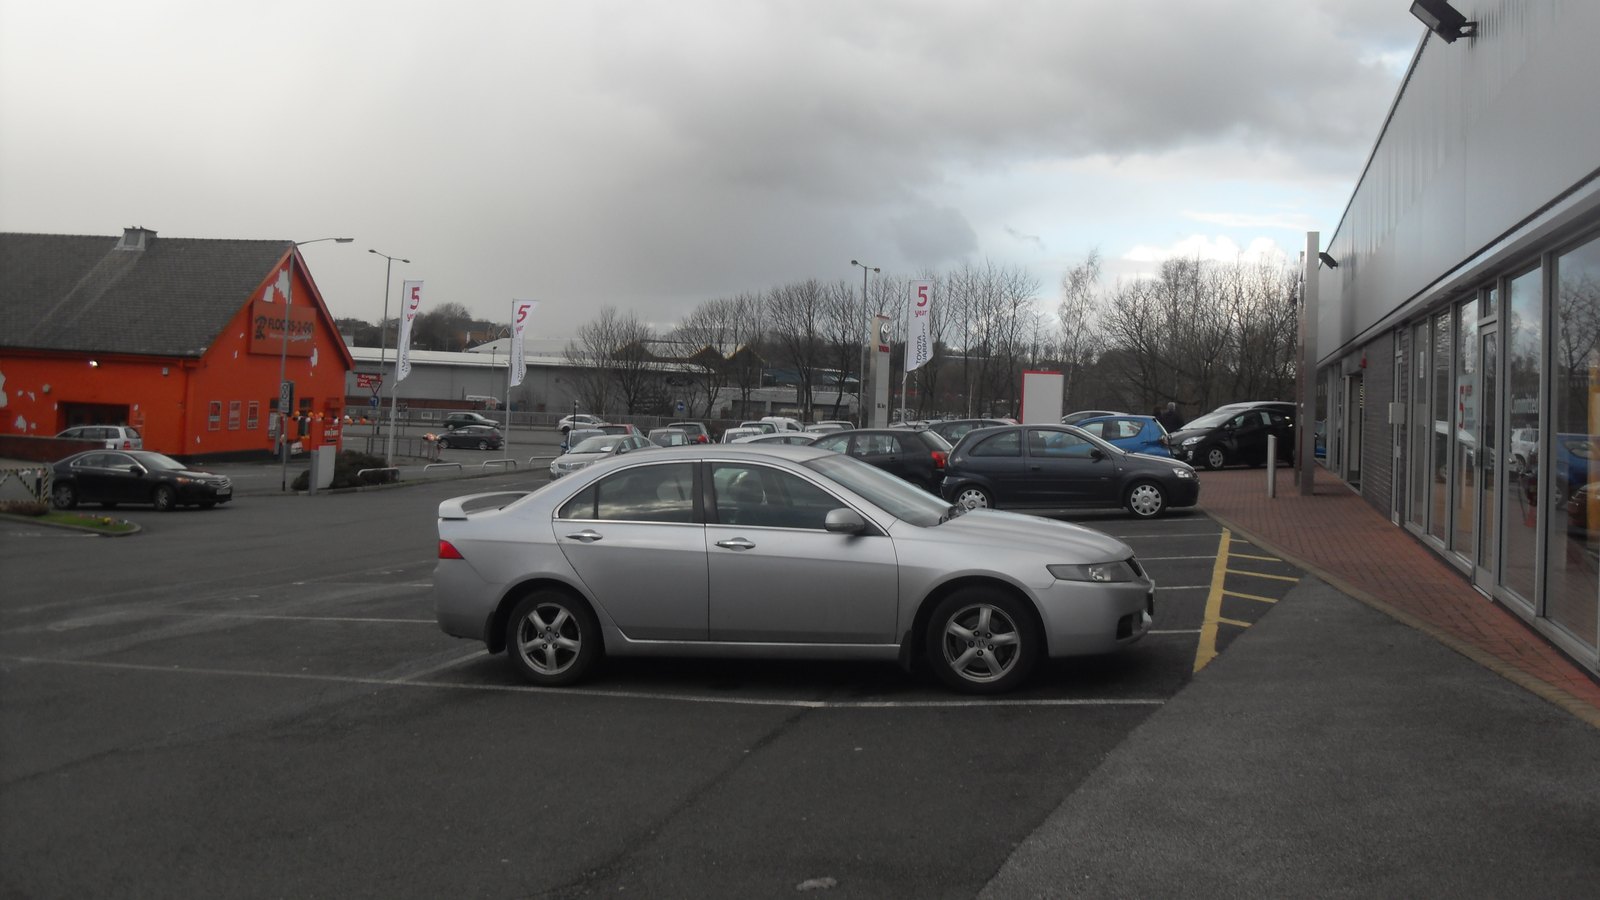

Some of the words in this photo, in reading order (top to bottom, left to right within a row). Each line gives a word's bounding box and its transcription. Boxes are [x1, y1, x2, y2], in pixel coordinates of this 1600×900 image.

[410, 287, 419, 309] 5
[917, 286, 927, 307] 5
[516, 305, 530, 323] 5
[914, 309, 928, 318] year
